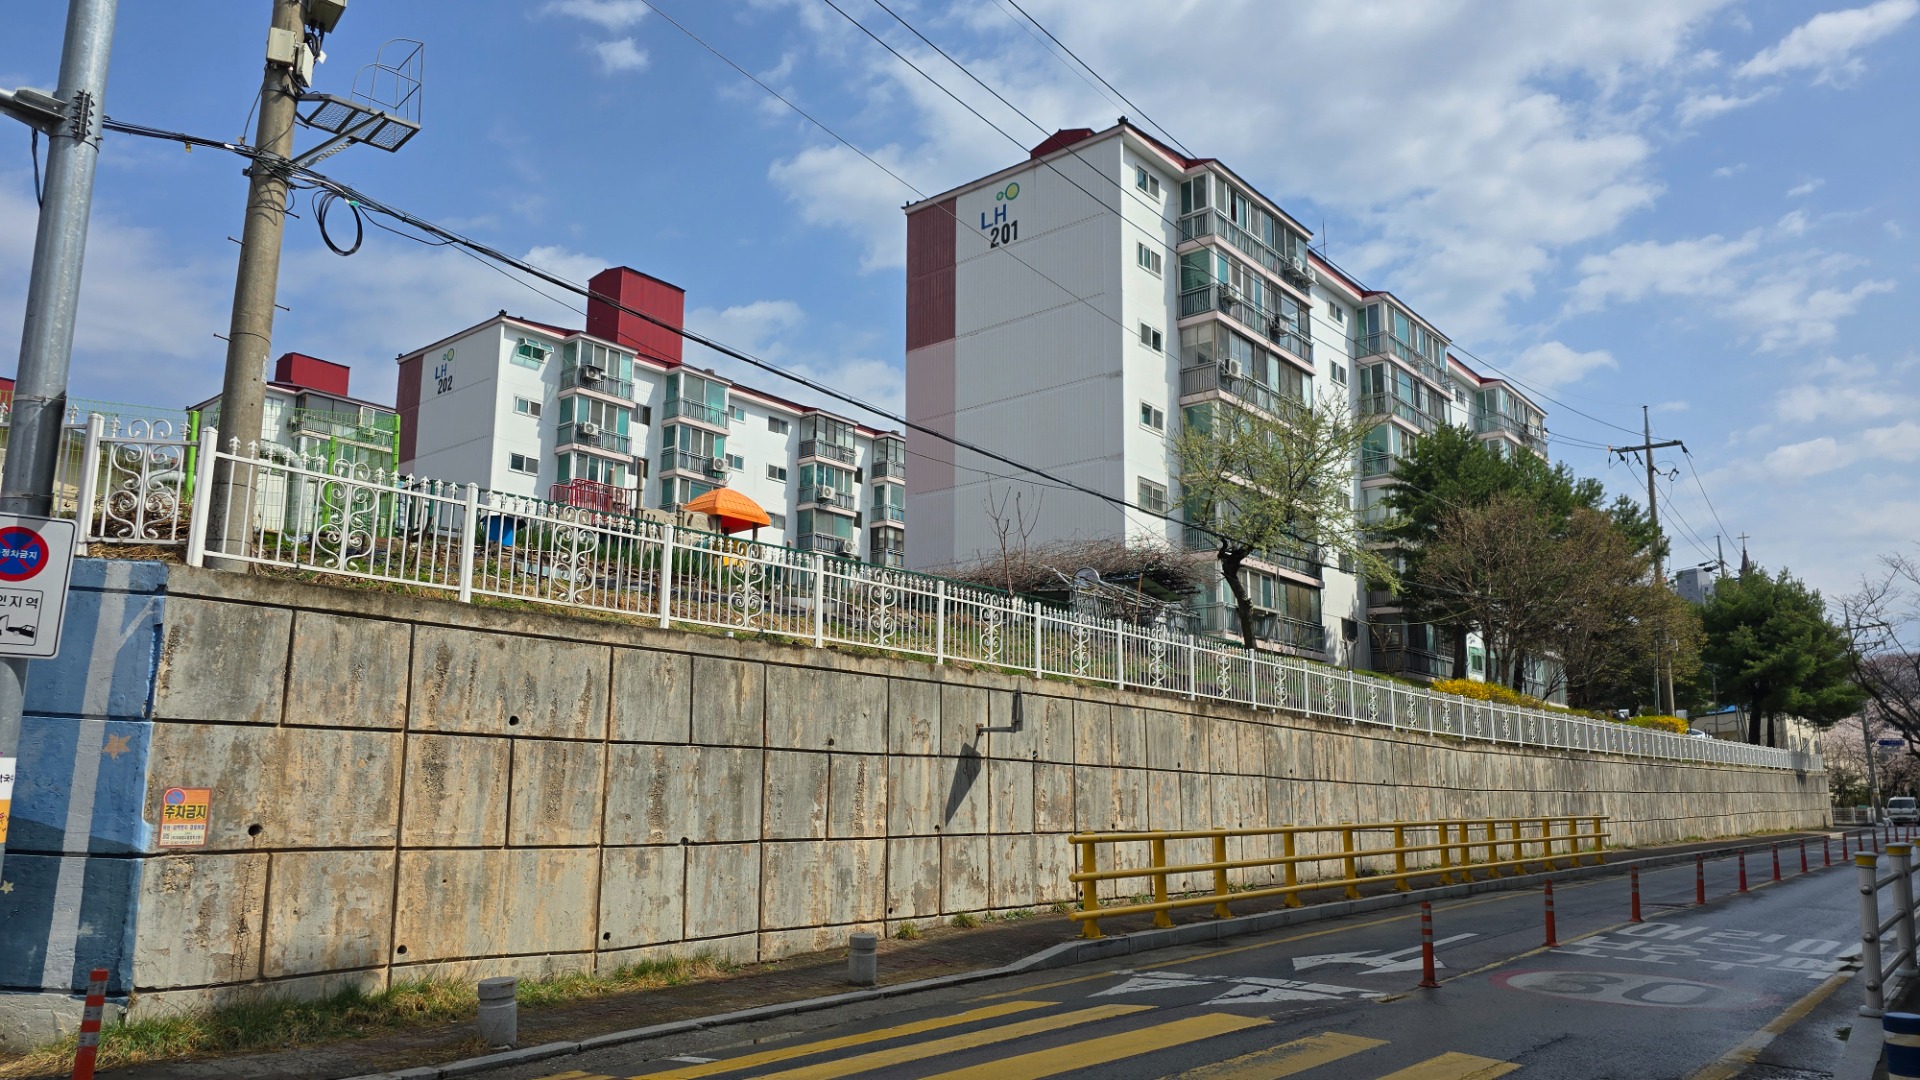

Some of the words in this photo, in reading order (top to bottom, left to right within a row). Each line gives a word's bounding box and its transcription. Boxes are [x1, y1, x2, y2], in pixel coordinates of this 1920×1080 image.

[981, 203, 1007, 230] LH
[990, 219, 1018, 249] 201
[434, 363, 448, 380] LH
[437, 375, 453, 395] 202
[0, 548, 38, 560] 정차금지
[165, 804, 207, 819] 주차금지
[1616, 922, 1864, 958] 어린이
[1550, 935, 1851, 979] 보호구역
[1524, 973, 1726, 1006] 30
